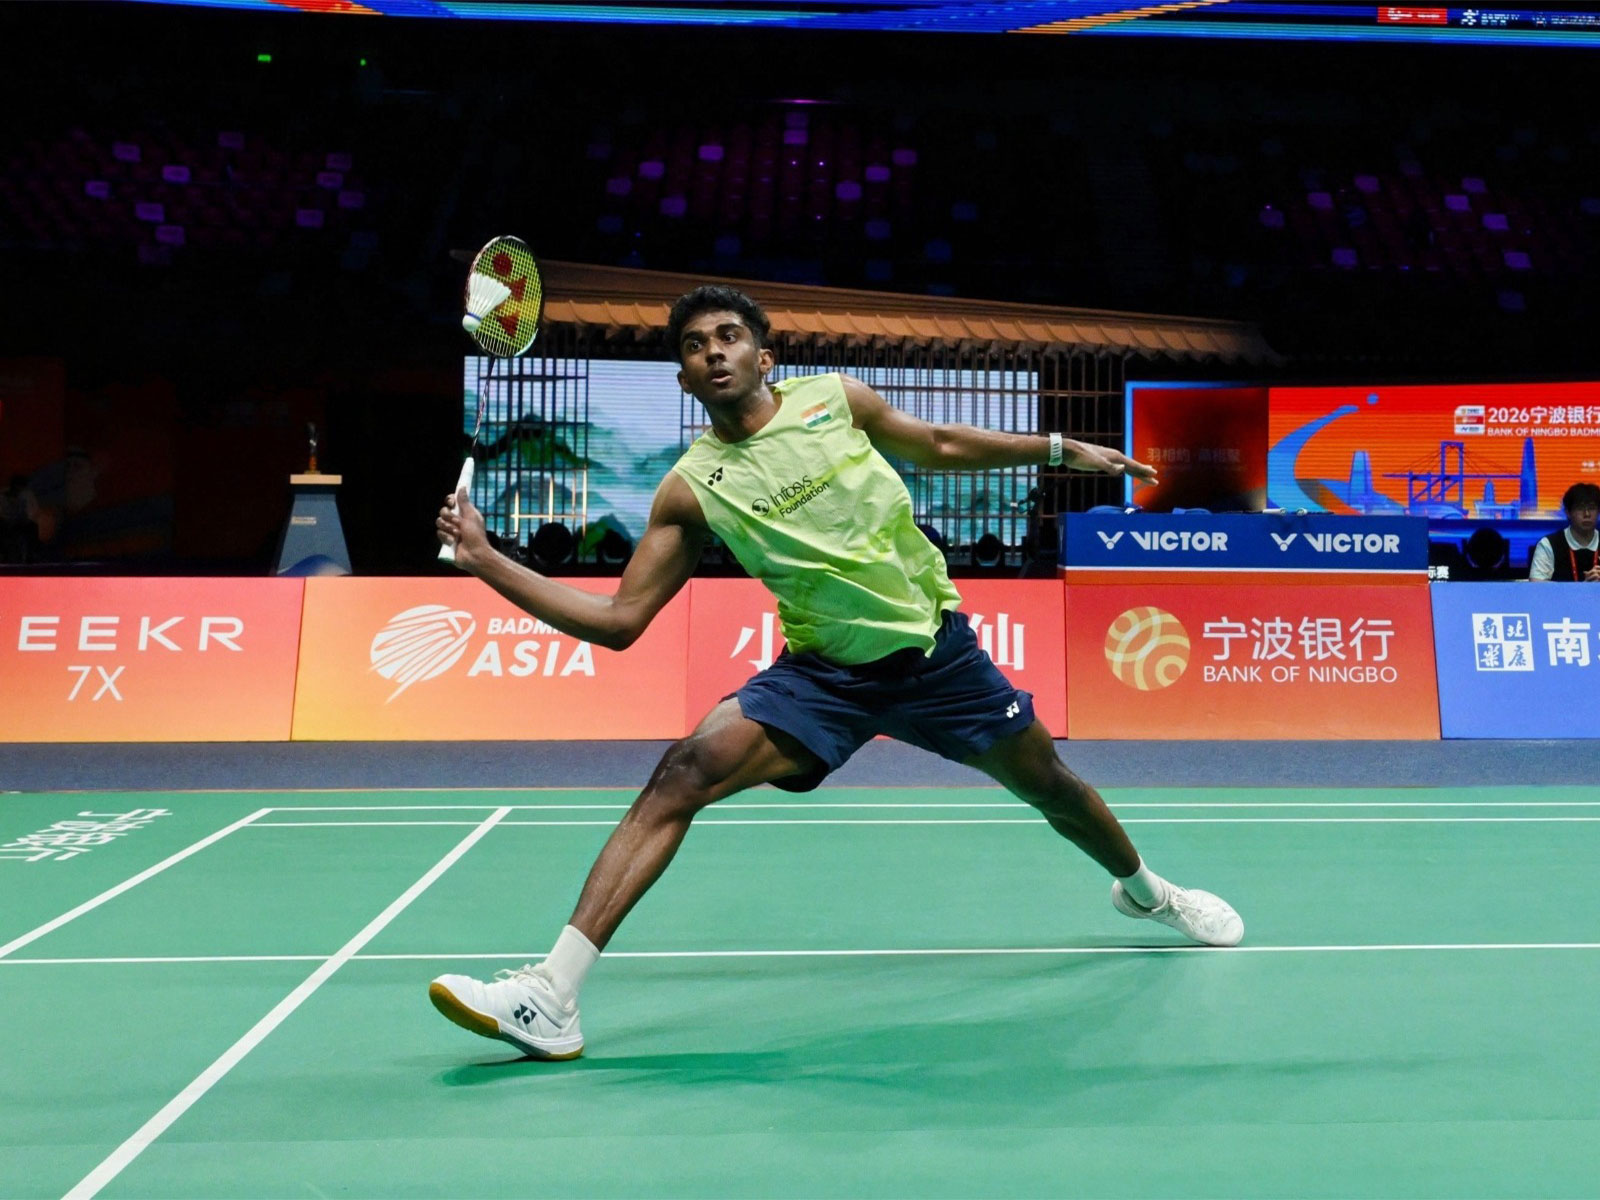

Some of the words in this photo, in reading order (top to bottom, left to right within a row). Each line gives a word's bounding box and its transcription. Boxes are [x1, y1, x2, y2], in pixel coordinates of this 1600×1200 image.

[1487, 427, 1513, 437] BANK
[1515, 427, 1529, 437] OF
[1531, 427, 1568, 437] NINGBO
[770, 475, 812, 507] Infosys
[779, 482, 830, 518] Foundation
[1130, 531, 1229, 551] VICTOR
[1303, 533, 1401, 553] VICTOR
[18, 616, 245, 652] EEKR
[487, 618, 563, 635] BADM
[1203, 616, 1395, 662] 宁波银行
[1542, 617, 1600, 667] 南
[467, 640, 596, 677] ASIA
[1203, 665, 1263, 683] BANK
[1271, 665, 1301, 683] OF
[1309, 665, 1398, 683] NINGBO
[67, 665, 126, 701] 7X
